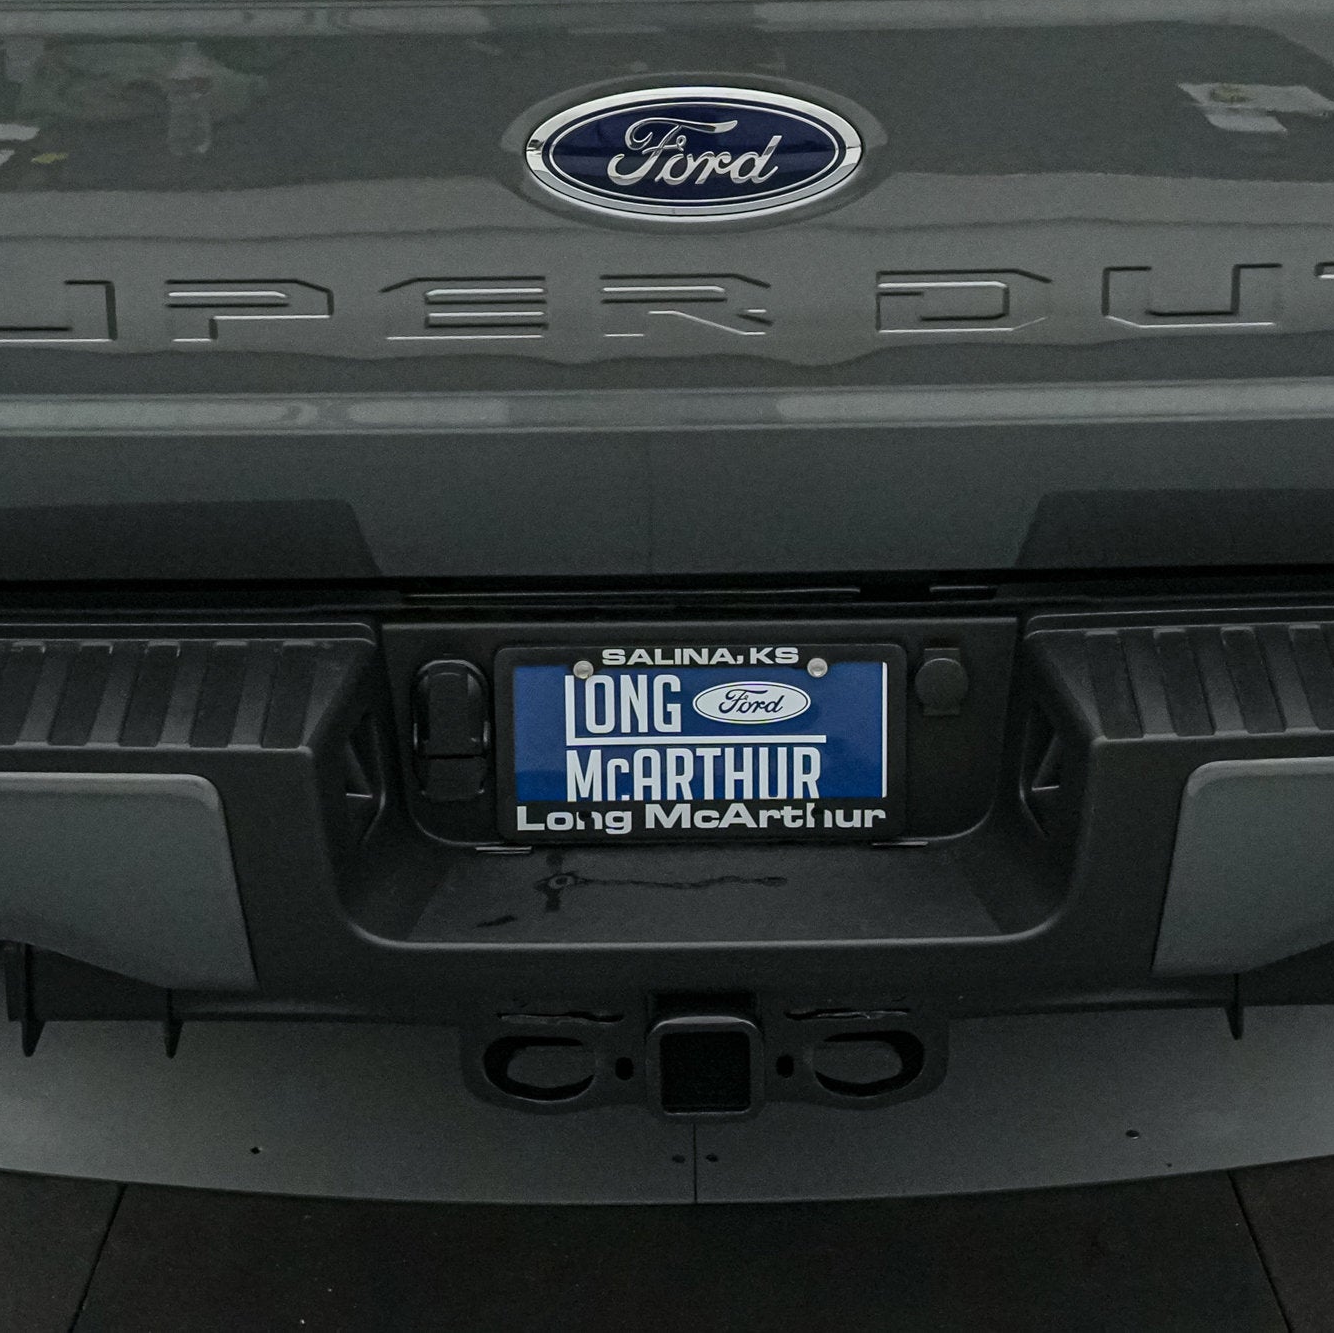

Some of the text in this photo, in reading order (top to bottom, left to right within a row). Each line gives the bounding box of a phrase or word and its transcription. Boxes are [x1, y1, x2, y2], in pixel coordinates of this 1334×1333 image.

[606, 116, 783, 186] Ford
[601, 646, 800, 666] SALINA, KS
[564, 674, 784, 743] LONG Ford
[566, 746, 822, 802] McARTHUR
[516, 802, 887, 835] Long McArthur
